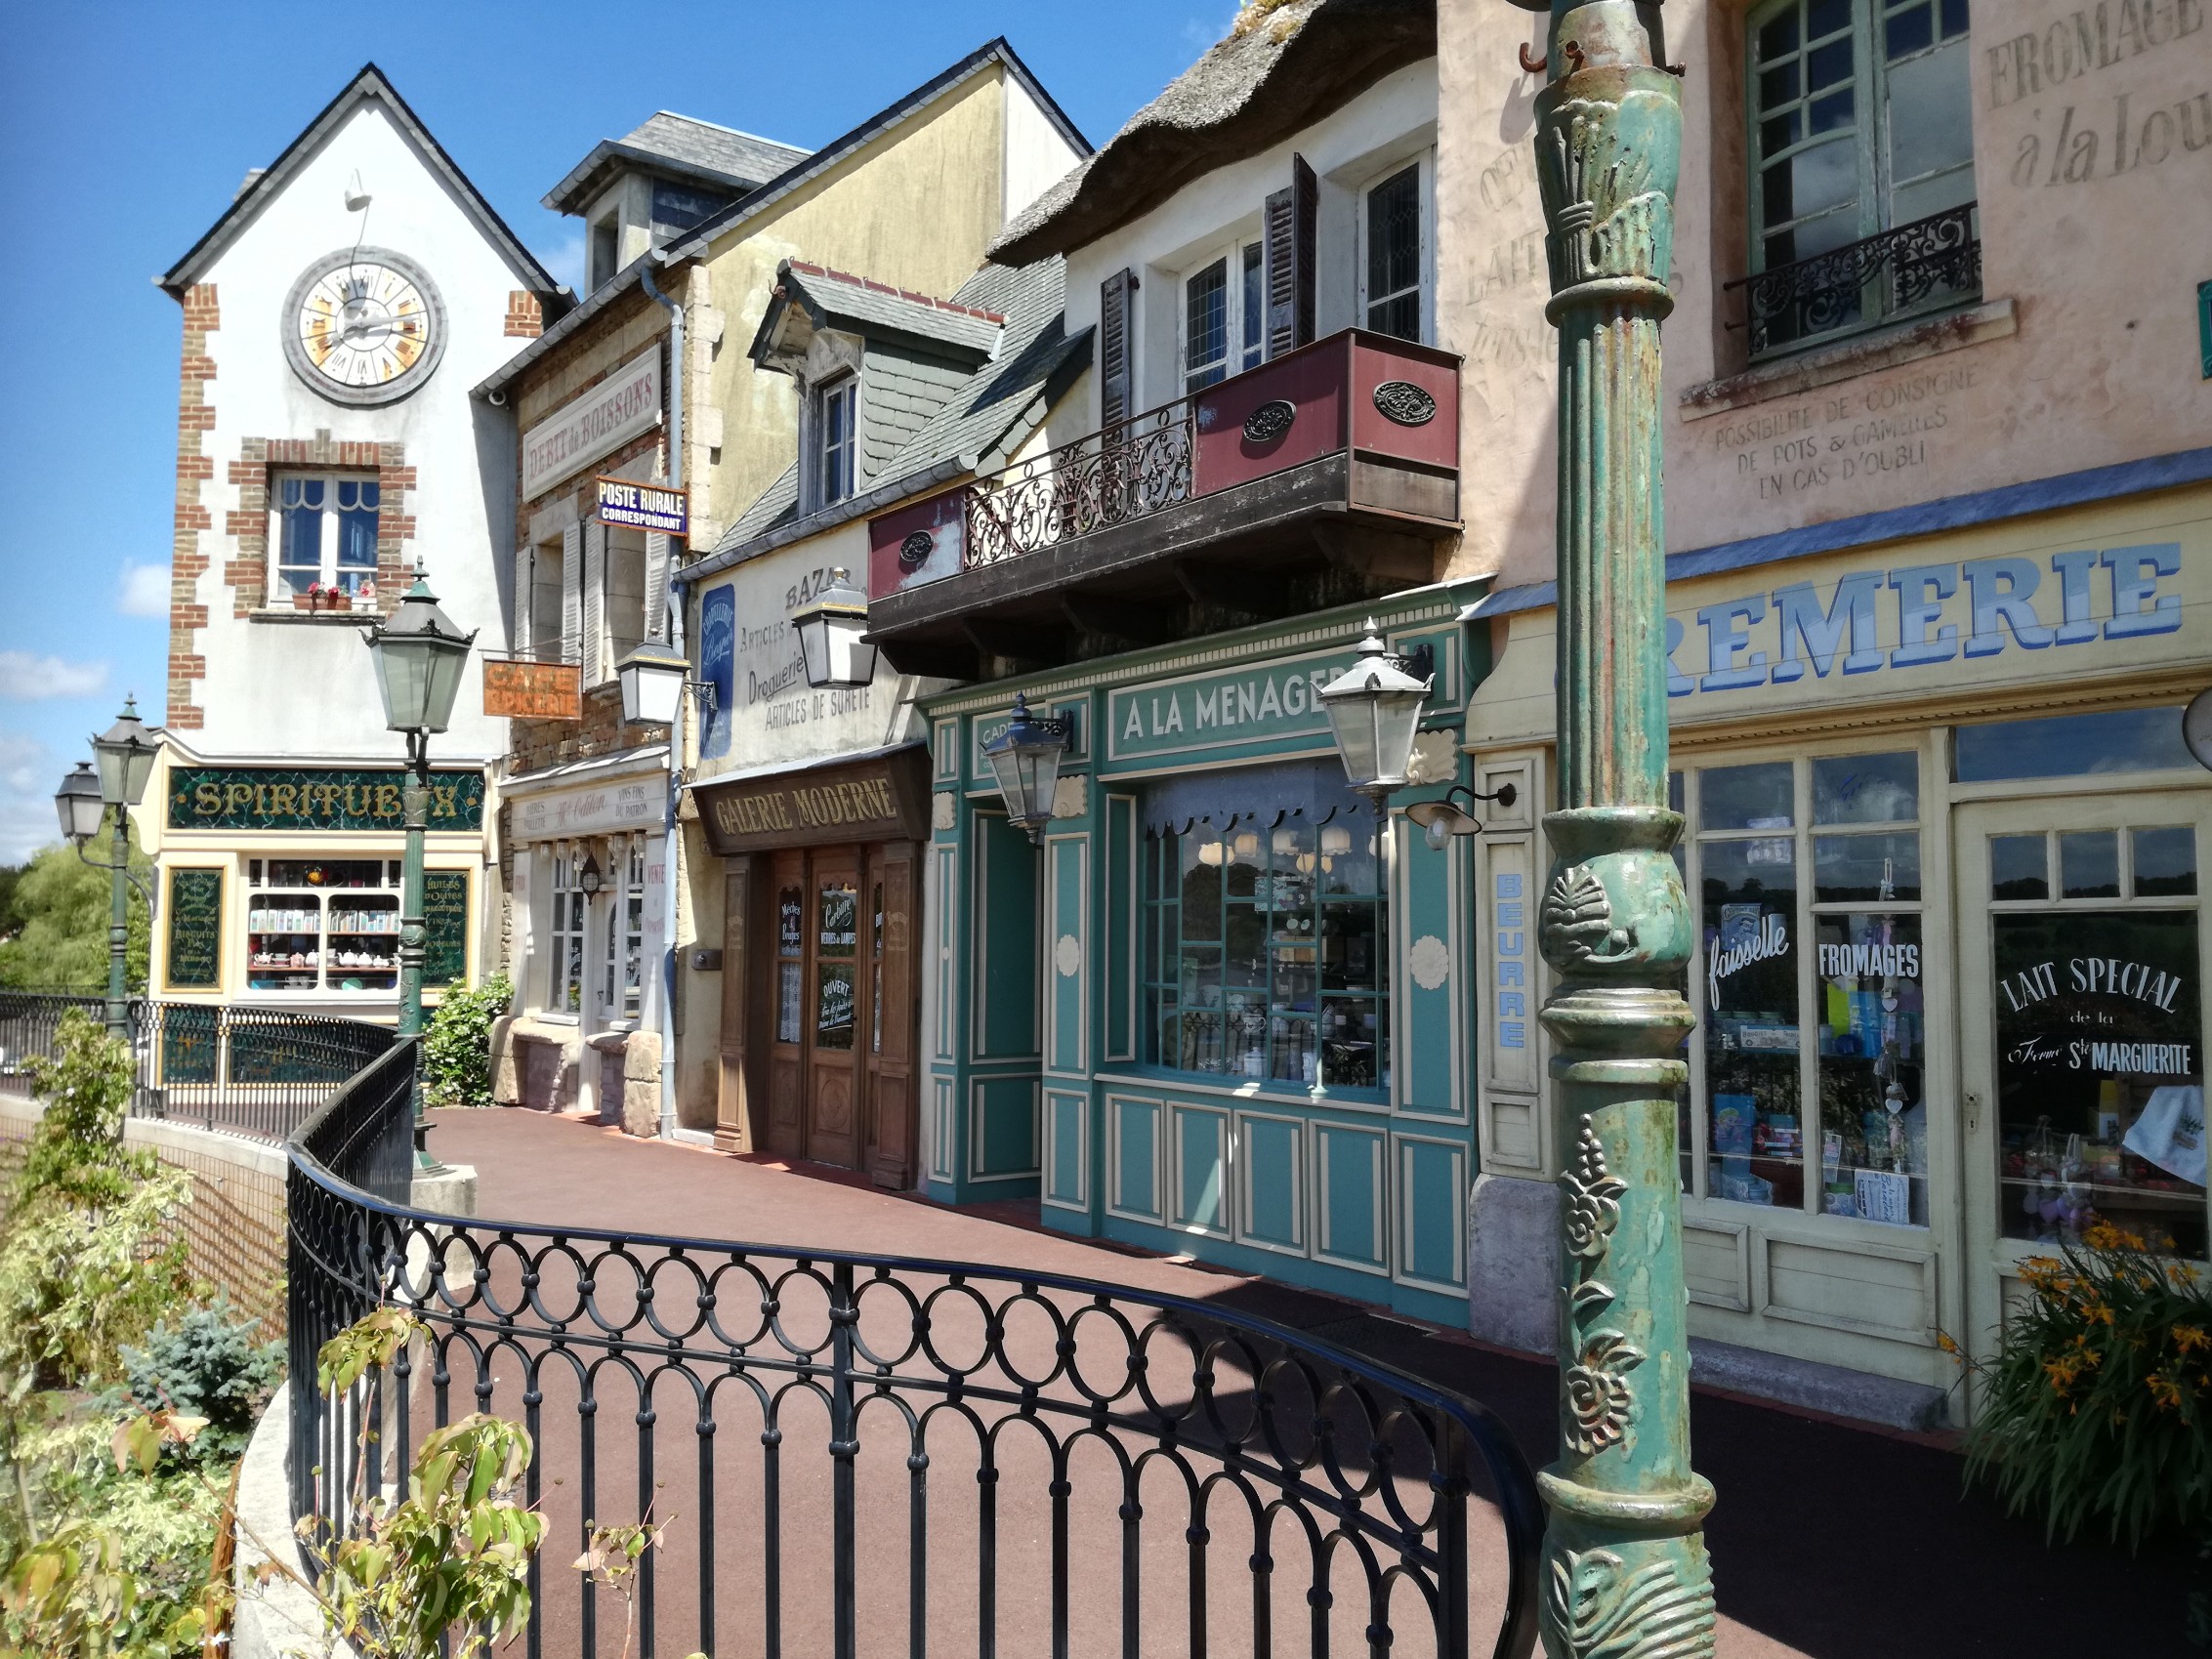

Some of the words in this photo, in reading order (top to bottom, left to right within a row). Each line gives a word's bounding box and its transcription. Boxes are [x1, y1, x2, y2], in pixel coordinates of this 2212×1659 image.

[2045, 105, 2100, 187] la
[581, 372, 652, 447] BOISSONS
[1826, 395, 1850, 423] DE
[1865, 367, 1980, 412] CONSIGNE
[1737, 451, 1758, 475] DE
[1774, 435, 1818, 466] POTS
[1829, 435, 1846, 453] &
[1759, 473, 1783, 500] EN
[1793, 463, 1829, 490] CAS
[1842, 440, 1926, 481] D'OUBLI
[599, 481, 638, 509] POSTE
[641, 488, 685, 516] RURALE
[602, 508, 682, 530] CORRESPONDANT
[739, 620, 784, 652] ARTICLES
[748, 650, 805, 706] Droguerie
[765, 697, 808, 731] ARTICLES
[813, 693, 825, 721] DE
[1123, 697, 1144, 740] A
[1152, 690, 1184, 735] LA
[195, 781, 458, 818] SPIRITUEX
[625, 802, 648, 818] PATRON
[716, 792, 793, 836] GALERIE
[792, 777, 897, 828] MODERNE
[647, 863, 665, 884] VENTE
[1496, 874, 1525, 1049] BEURRE
[1708, 915, 1790, 1012] faisselle
[1818, 943, 1919, 977] FROMAGES
[823, 979, 851, 997] OUVERT
[2000, 961, 2059, 1013] LAIT
[2069, 957, 2182, 1015] SPECIAL
[2069, 1010, 2091, 1024] de
[2099, 1011, 2115, 1024] la
[2091, 1042, 2191, 1075] MARGUERITE
